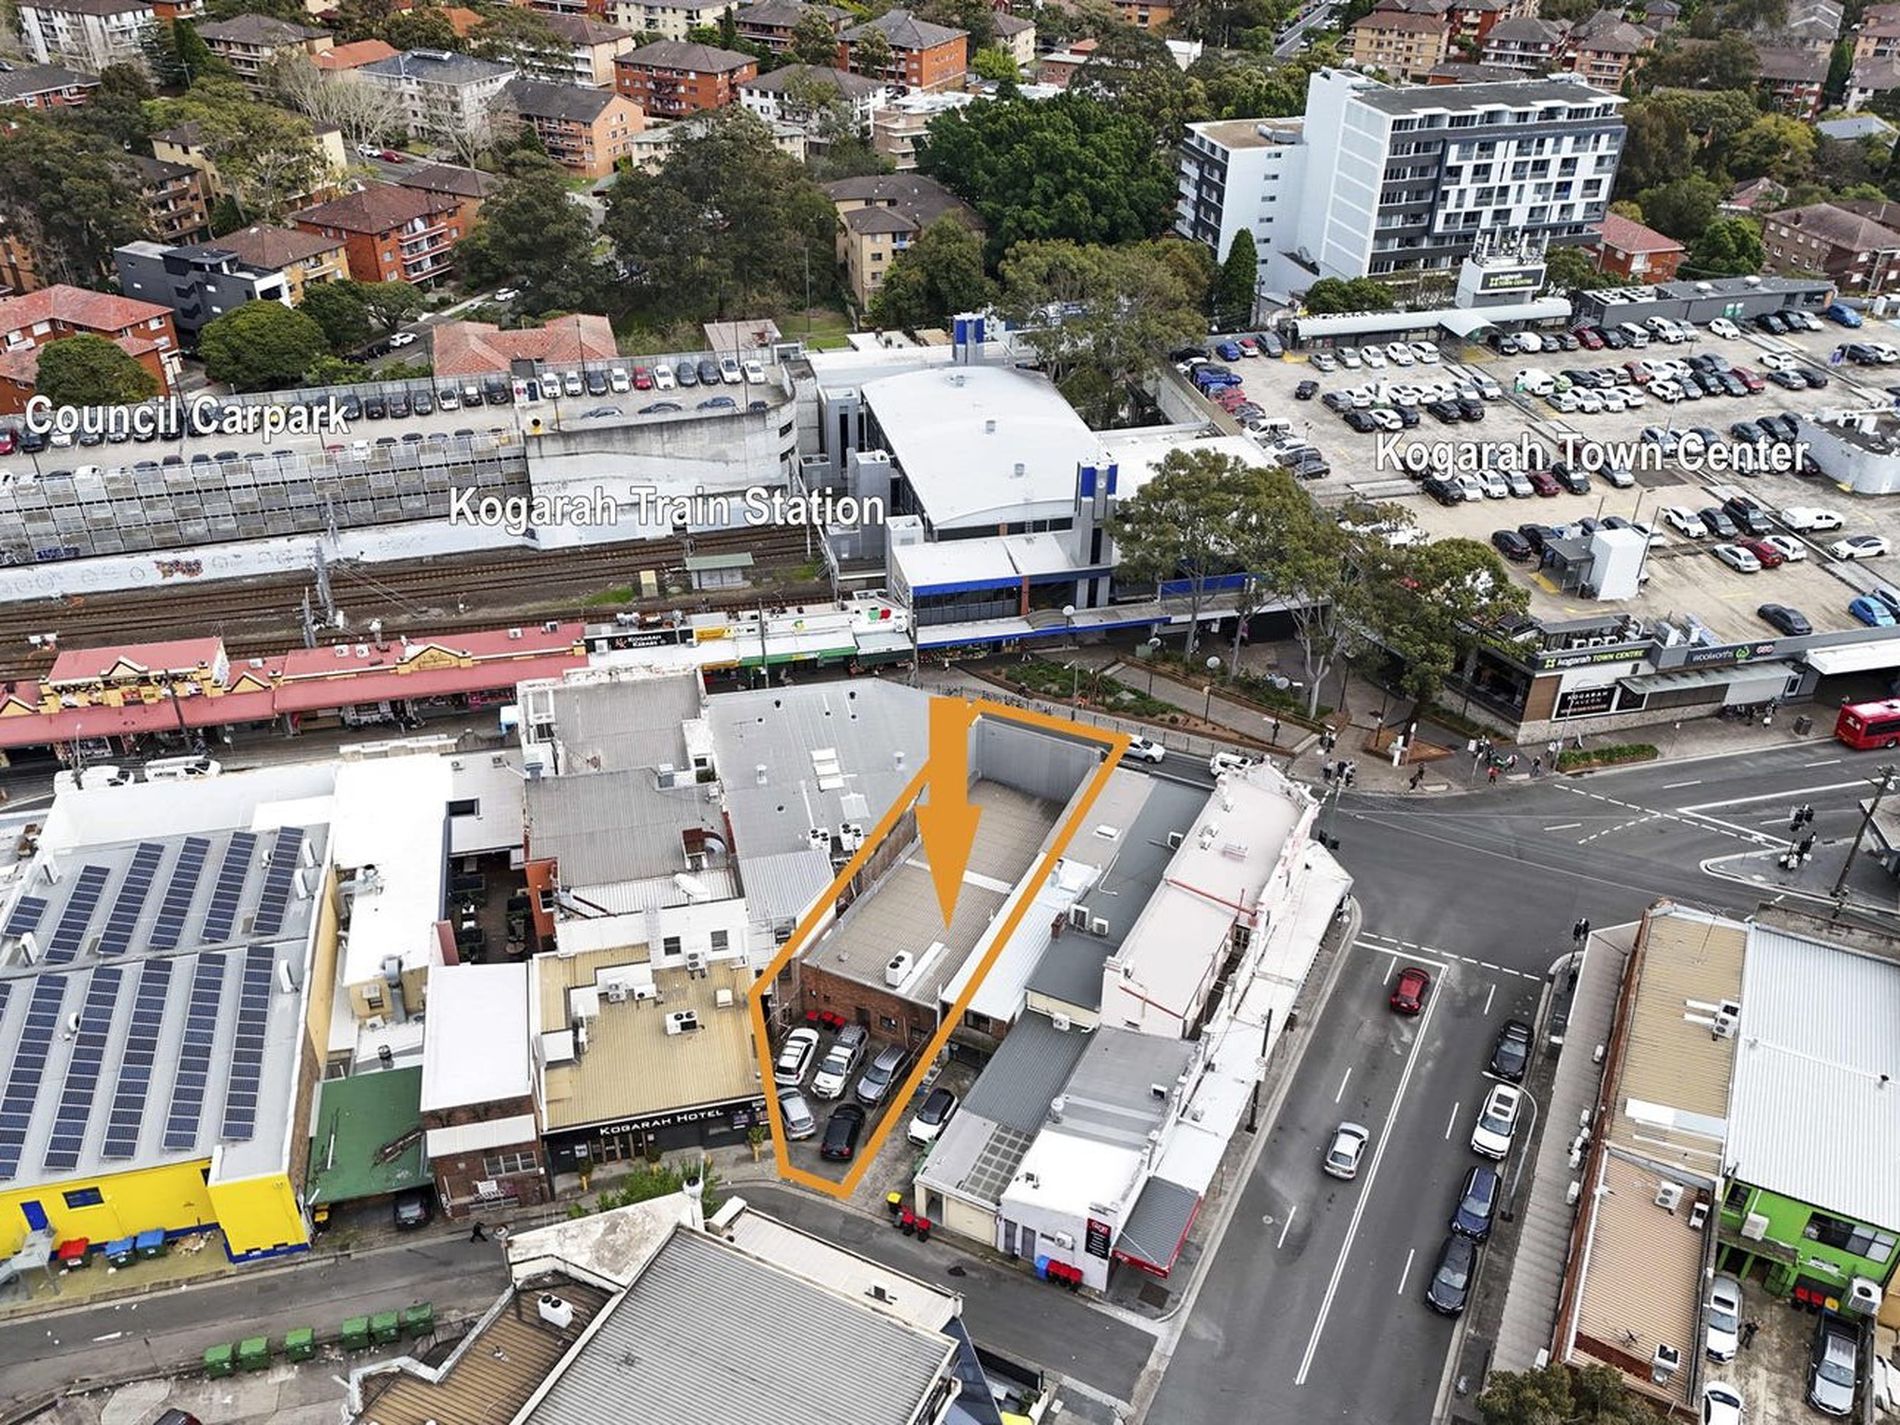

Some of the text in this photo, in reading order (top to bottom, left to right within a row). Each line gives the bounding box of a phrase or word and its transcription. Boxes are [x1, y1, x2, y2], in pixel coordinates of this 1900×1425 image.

[1592, 654, 1614, 662] TOWN
[1615, 650, 1645, 660] CENTRE
[600, 1118, 672, 1136] KOGARAH
[677, 1109, 724, 1123] HOTEL
